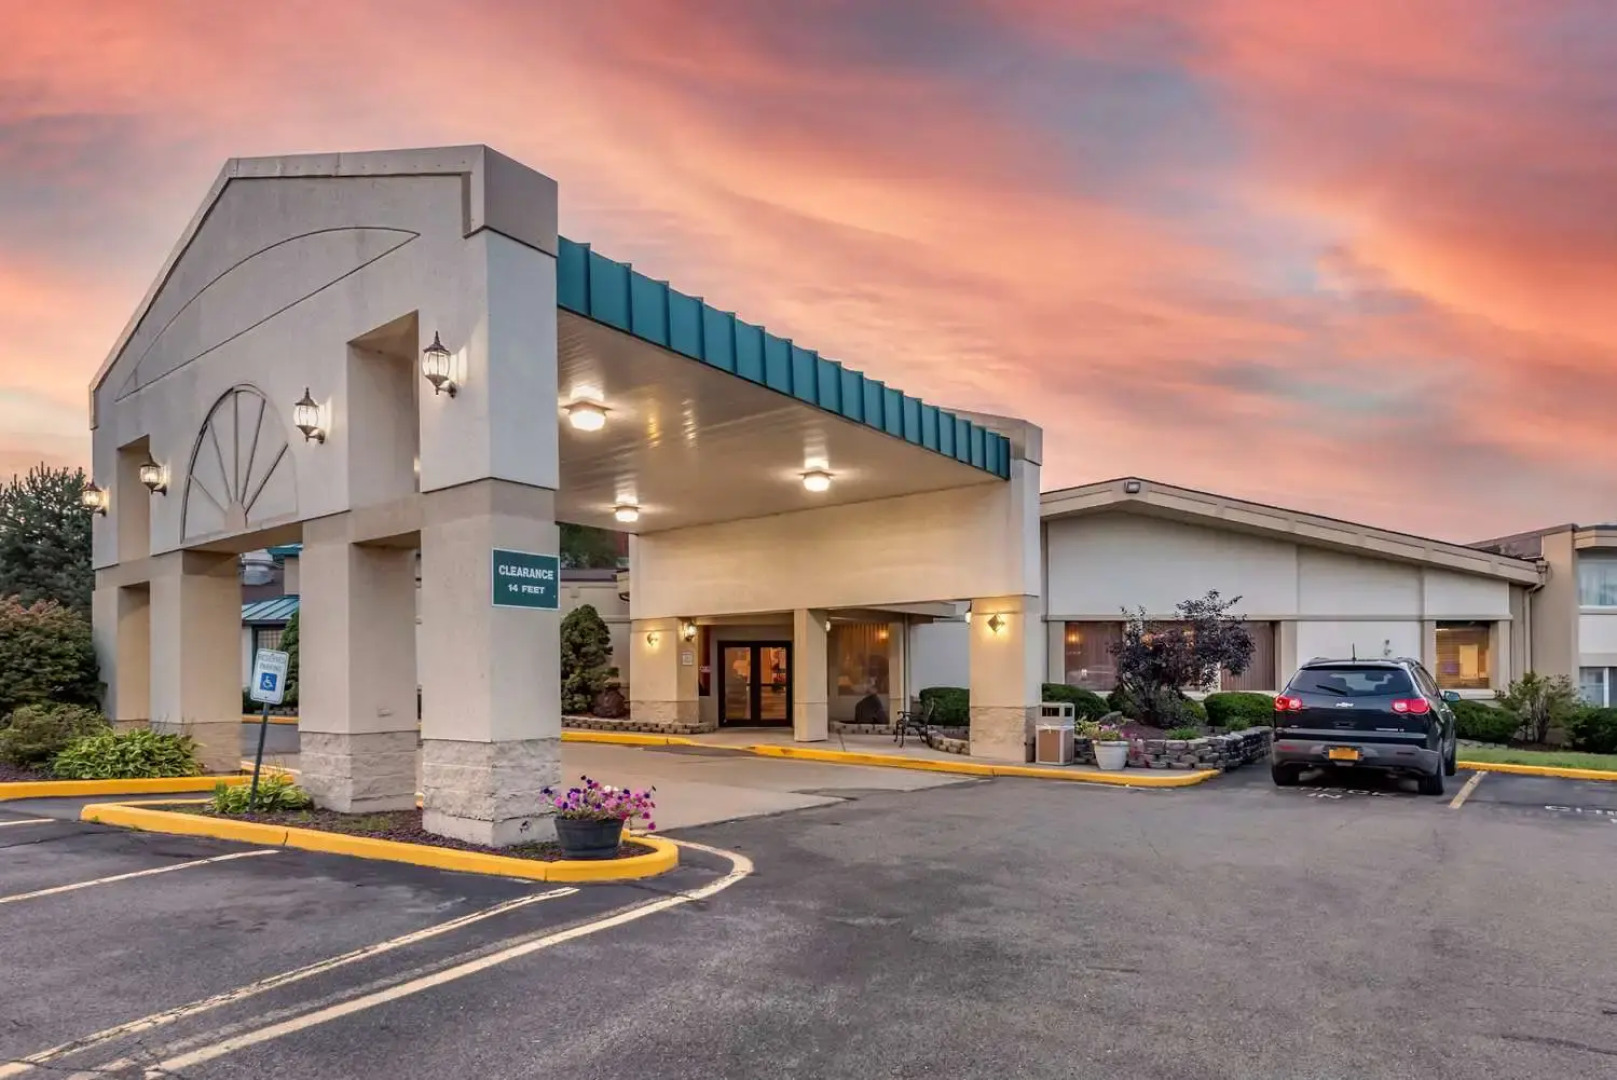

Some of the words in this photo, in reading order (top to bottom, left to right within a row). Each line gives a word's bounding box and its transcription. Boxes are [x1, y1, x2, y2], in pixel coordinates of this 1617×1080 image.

[498, 564, 554, 580] CLEARANCE
[507, 583, 519, 592] 14
[521, 584, 545, 594] FEET
